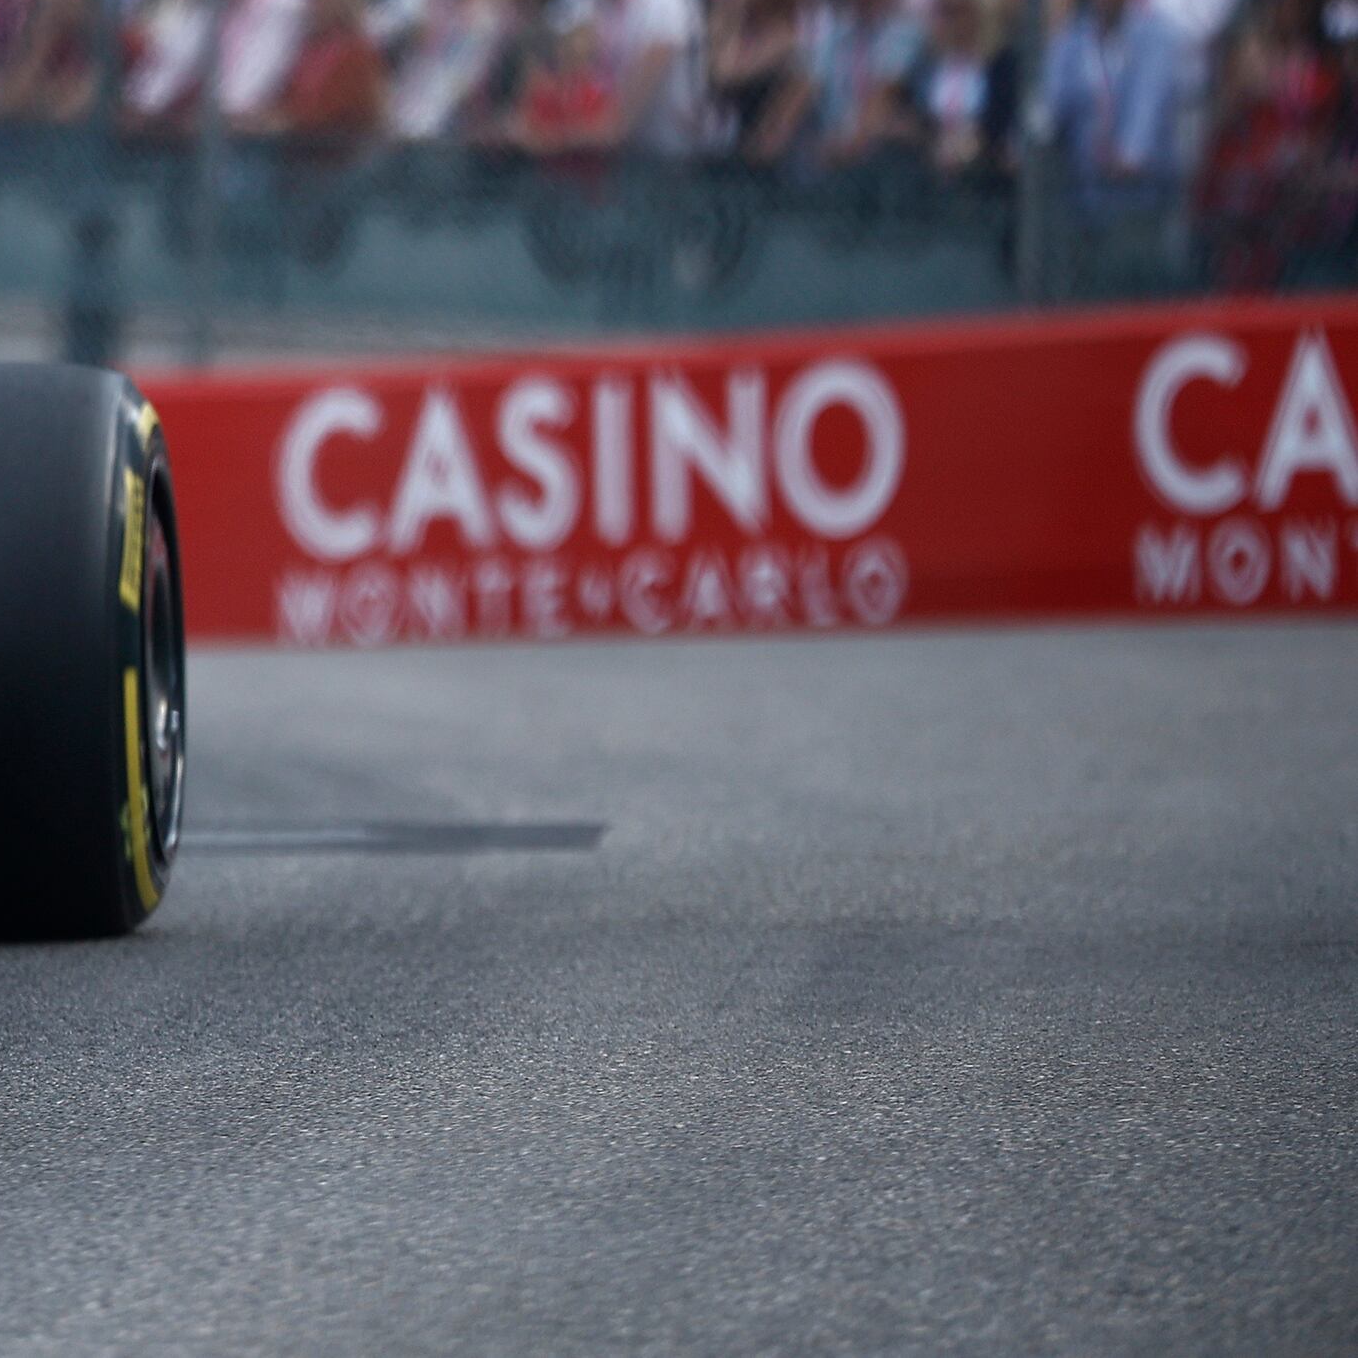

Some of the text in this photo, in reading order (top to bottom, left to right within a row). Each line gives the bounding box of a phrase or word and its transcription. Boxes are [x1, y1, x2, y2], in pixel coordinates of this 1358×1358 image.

[274, 355, 907, 564] CASINO
[1133, 325, 1358, 515] CA
[1134, 516, 1358, 605] MON
